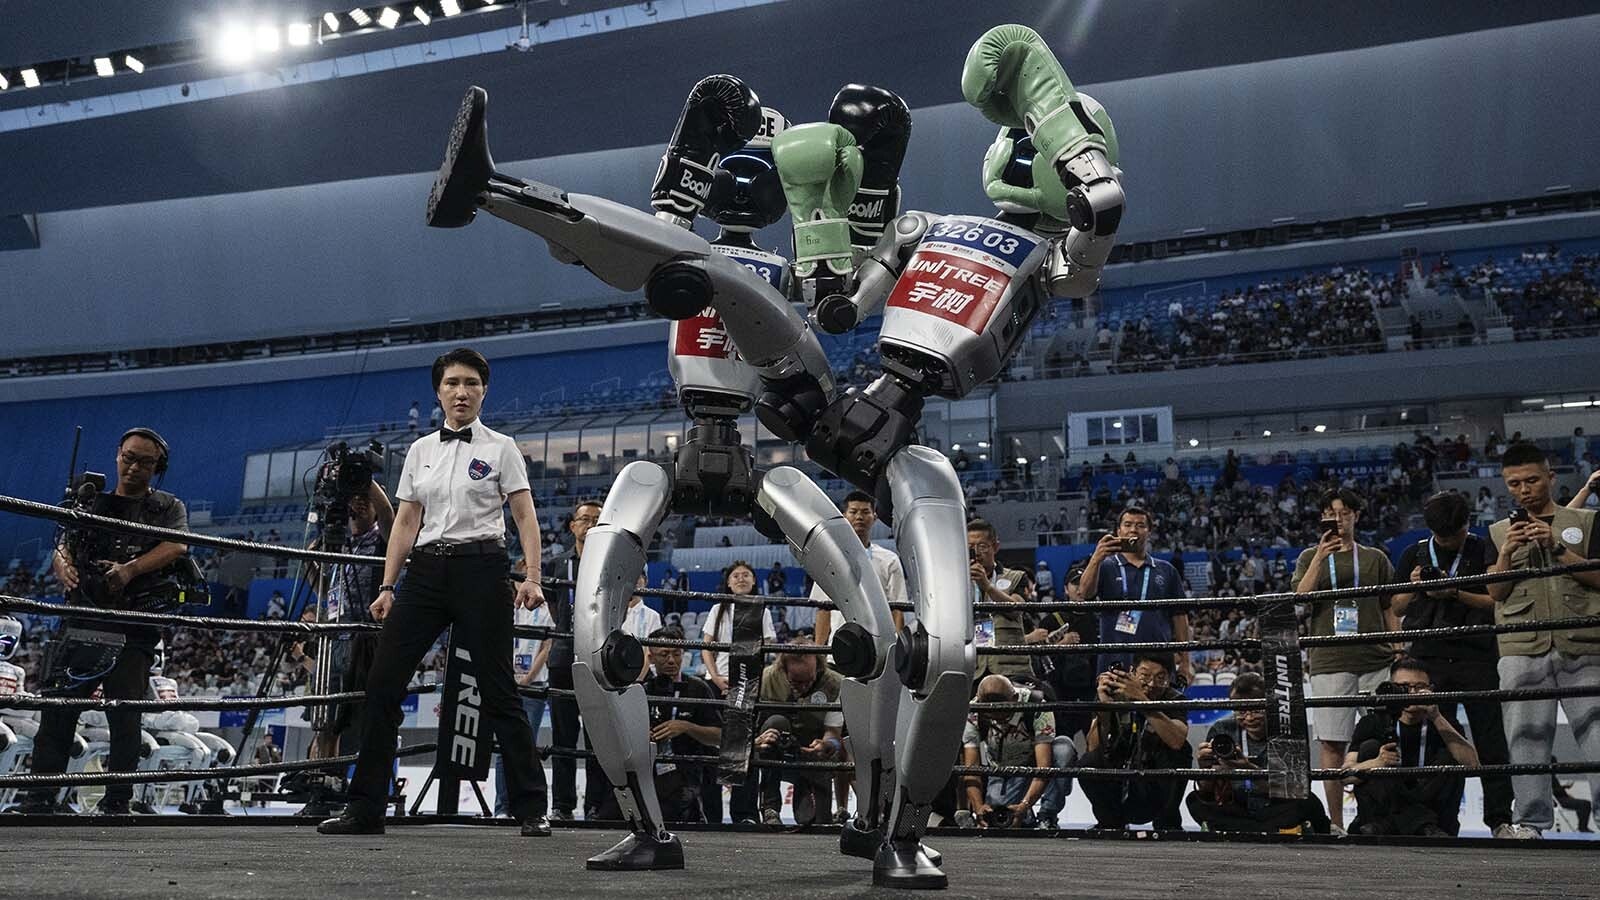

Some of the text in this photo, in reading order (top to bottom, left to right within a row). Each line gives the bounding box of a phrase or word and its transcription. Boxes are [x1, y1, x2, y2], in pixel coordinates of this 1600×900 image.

[848, 200, 884, 218] OOM!
[908, 260, 1004, 293] UNITREE
[908, 281, 975, 315] 宇树
